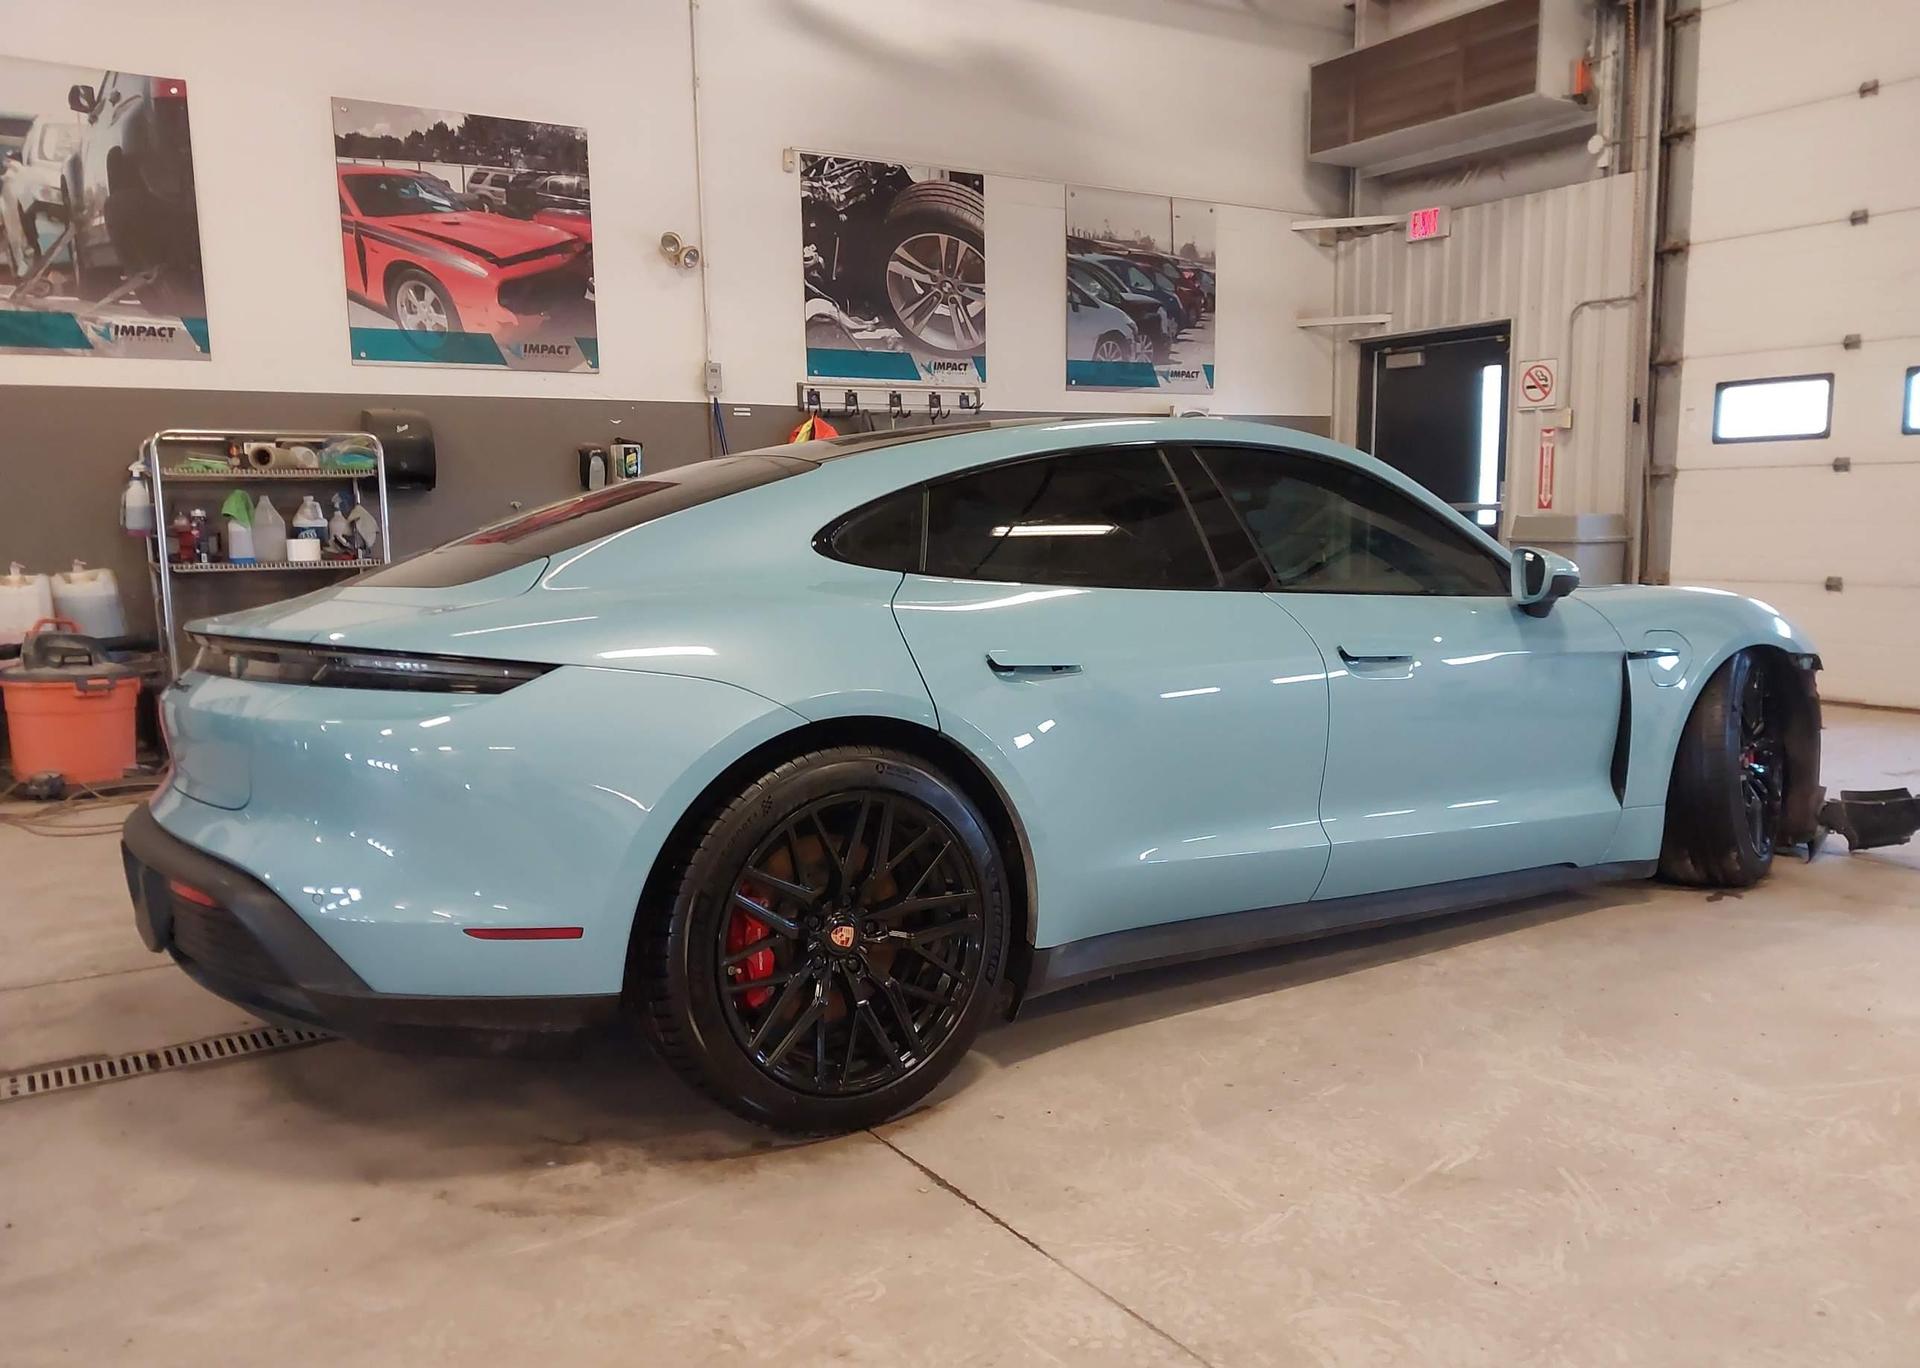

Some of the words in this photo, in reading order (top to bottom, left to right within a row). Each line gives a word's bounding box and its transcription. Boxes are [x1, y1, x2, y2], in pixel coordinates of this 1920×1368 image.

[114, 324, 176, 338] IMPACT
[523, 343, 571, 355] IMPACT
[933, 361, 968, 371] IMPACT
[1170, 370, 1200, 378] IMPACT
